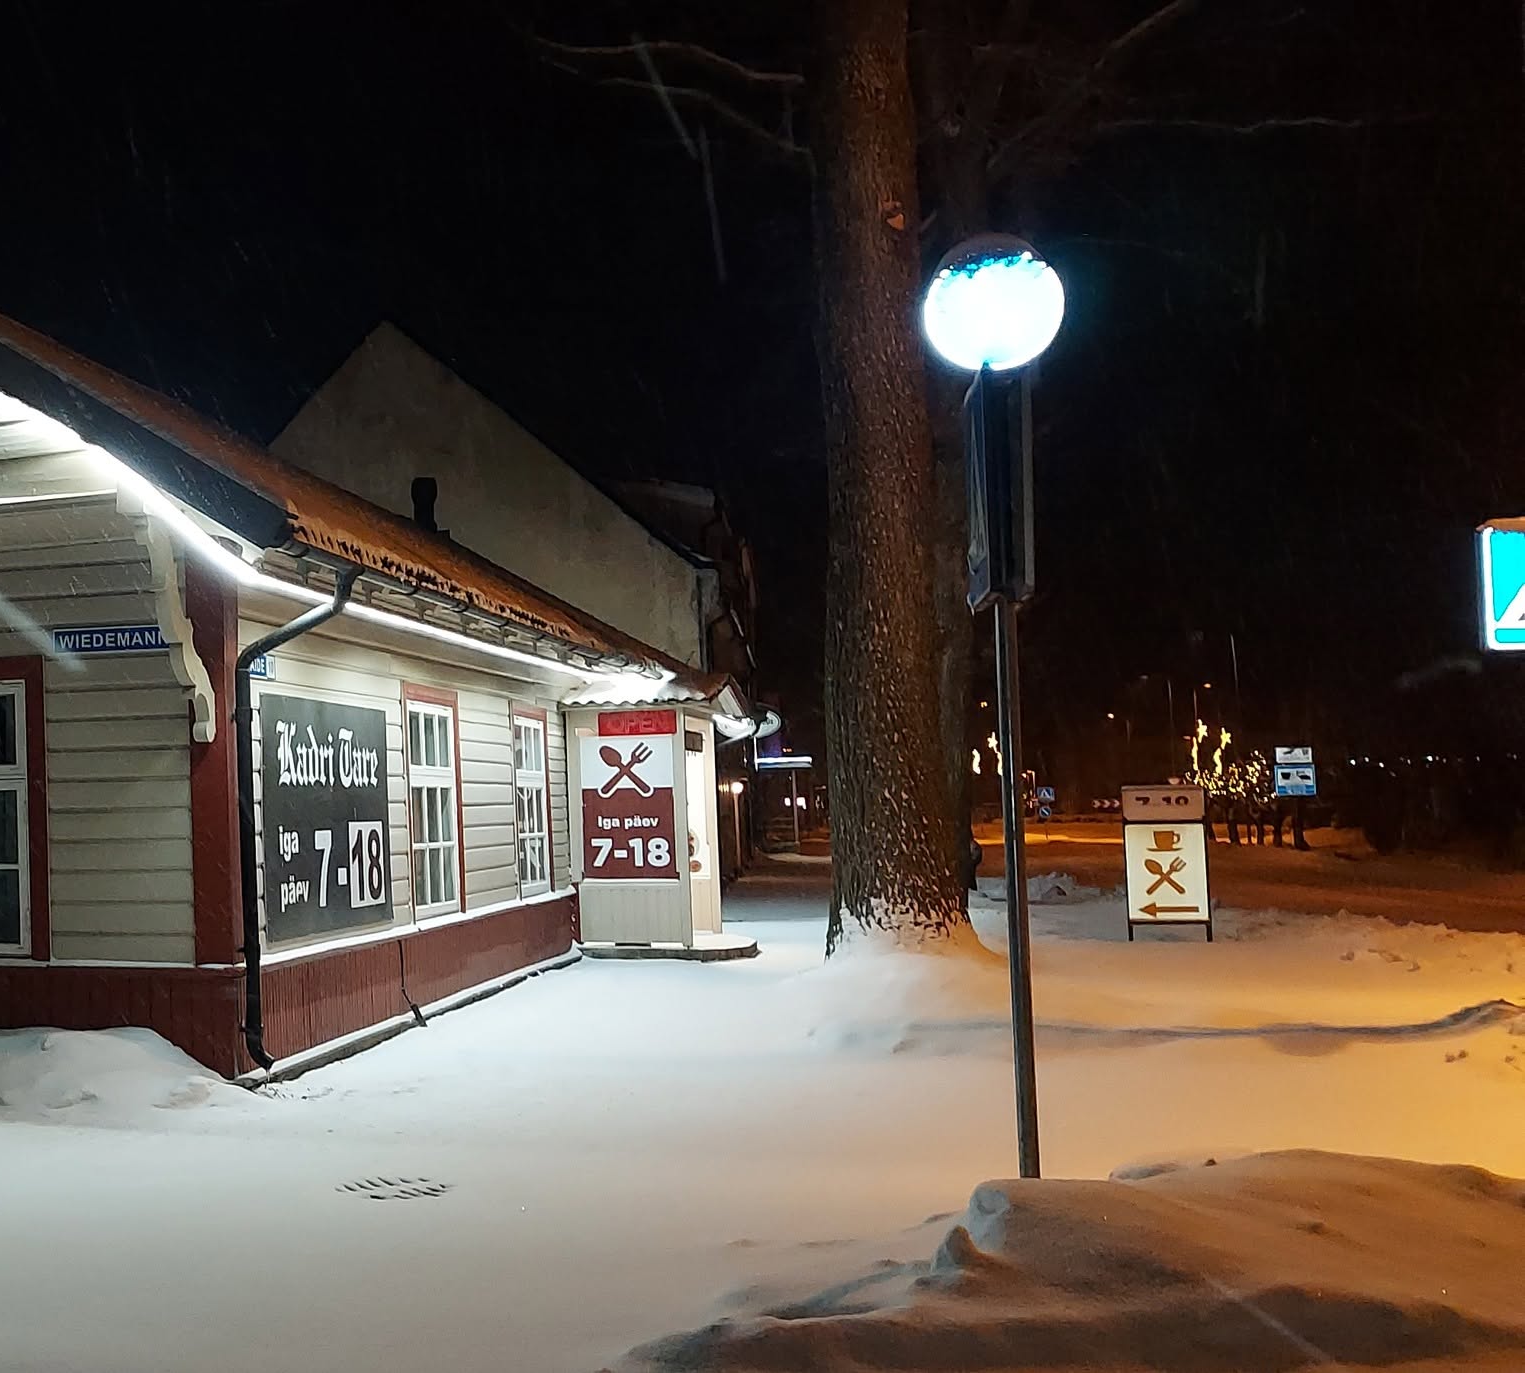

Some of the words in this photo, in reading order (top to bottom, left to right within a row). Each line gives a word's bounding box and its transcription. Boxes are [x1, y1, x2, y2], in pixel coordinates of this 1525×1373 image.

[276, 720, 335, 787] Kadri
[338, 727, 379, 789] Tare
[624, 814, 659, 830] päev
[278, 825, 300, 862] iga
[591, 837, 671, 867] 7-18
[280, 874, 311, 912] päev
